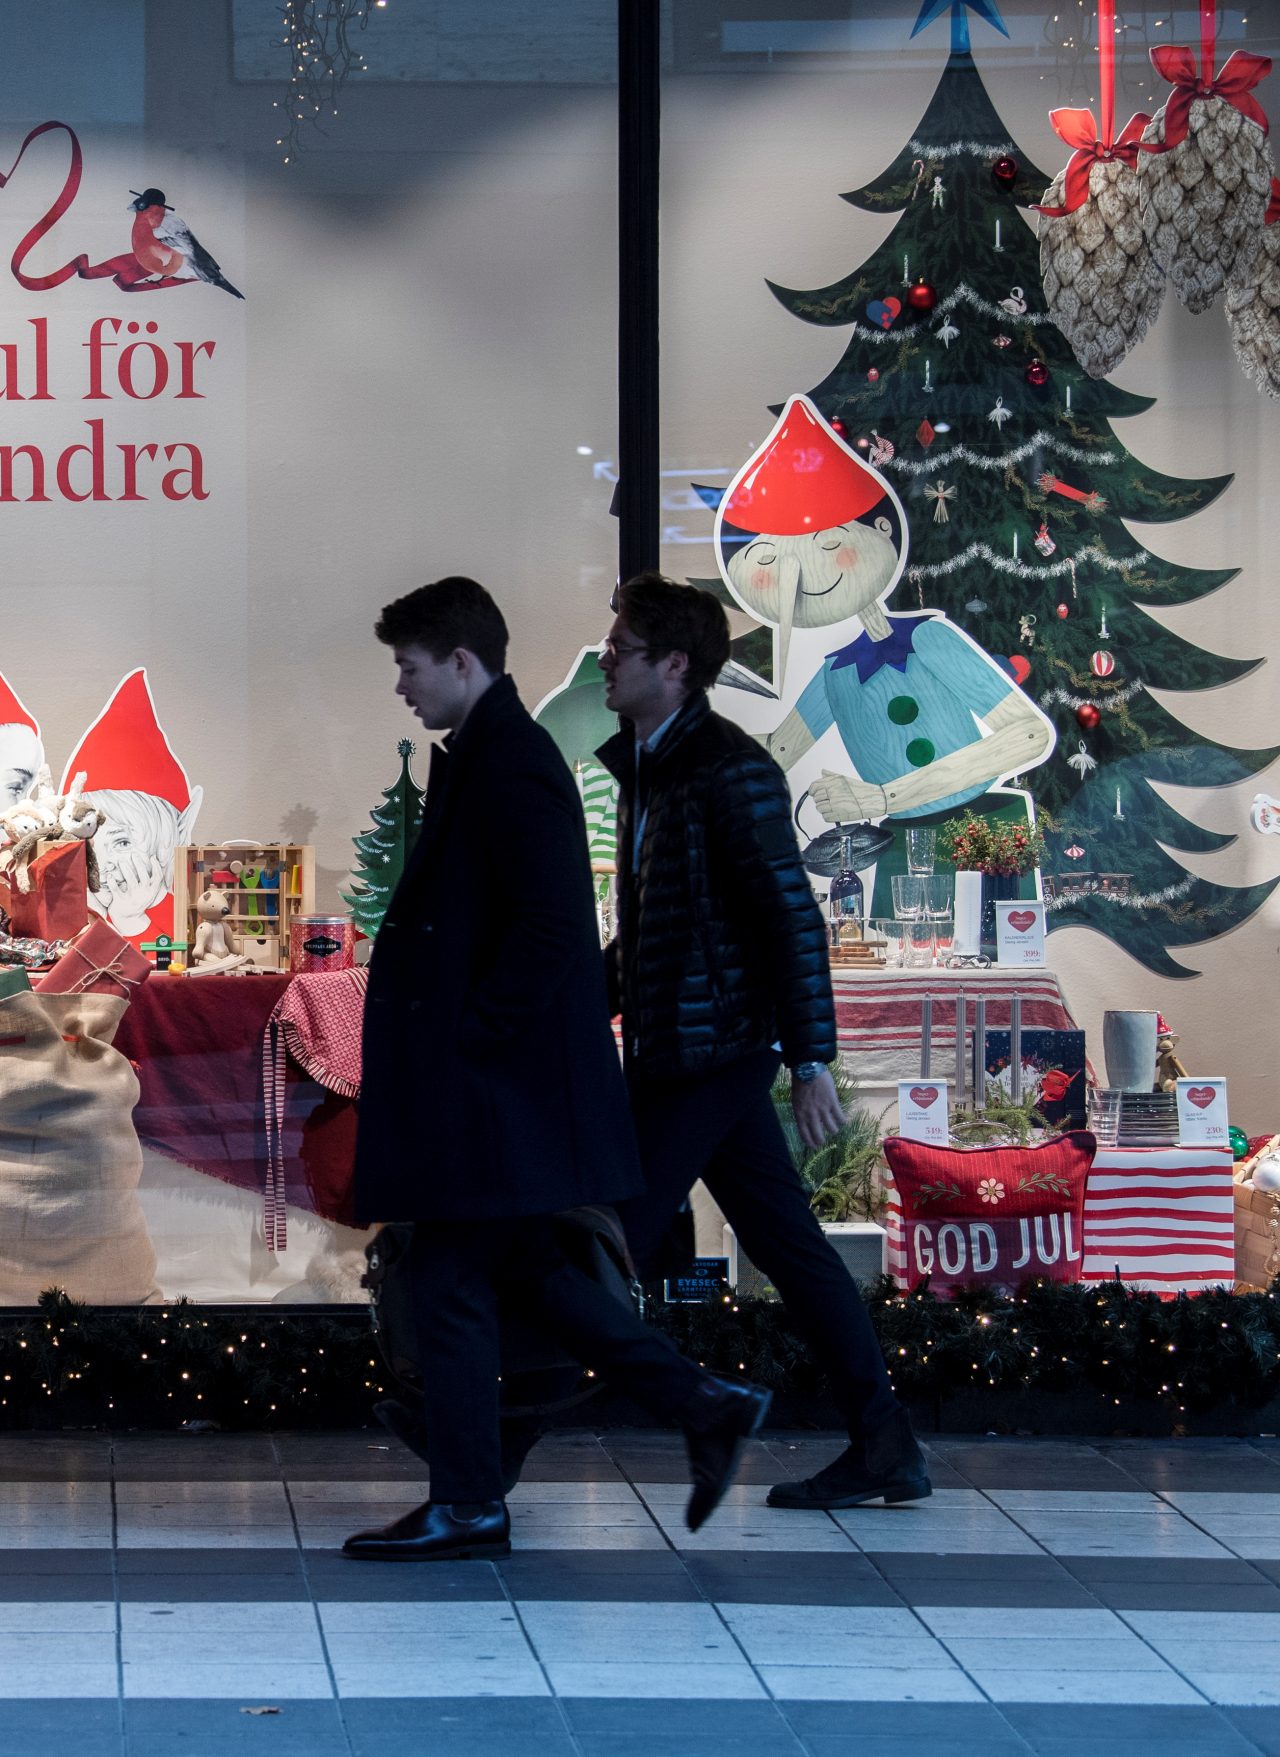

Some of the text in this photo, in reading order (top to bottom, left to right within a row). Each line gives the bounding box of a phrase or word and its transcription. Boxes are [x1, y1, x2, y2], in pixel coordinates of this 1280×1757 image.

[81, 316, 217, 400] för
[913, 1211, 1081, 1276] GOD JUL
